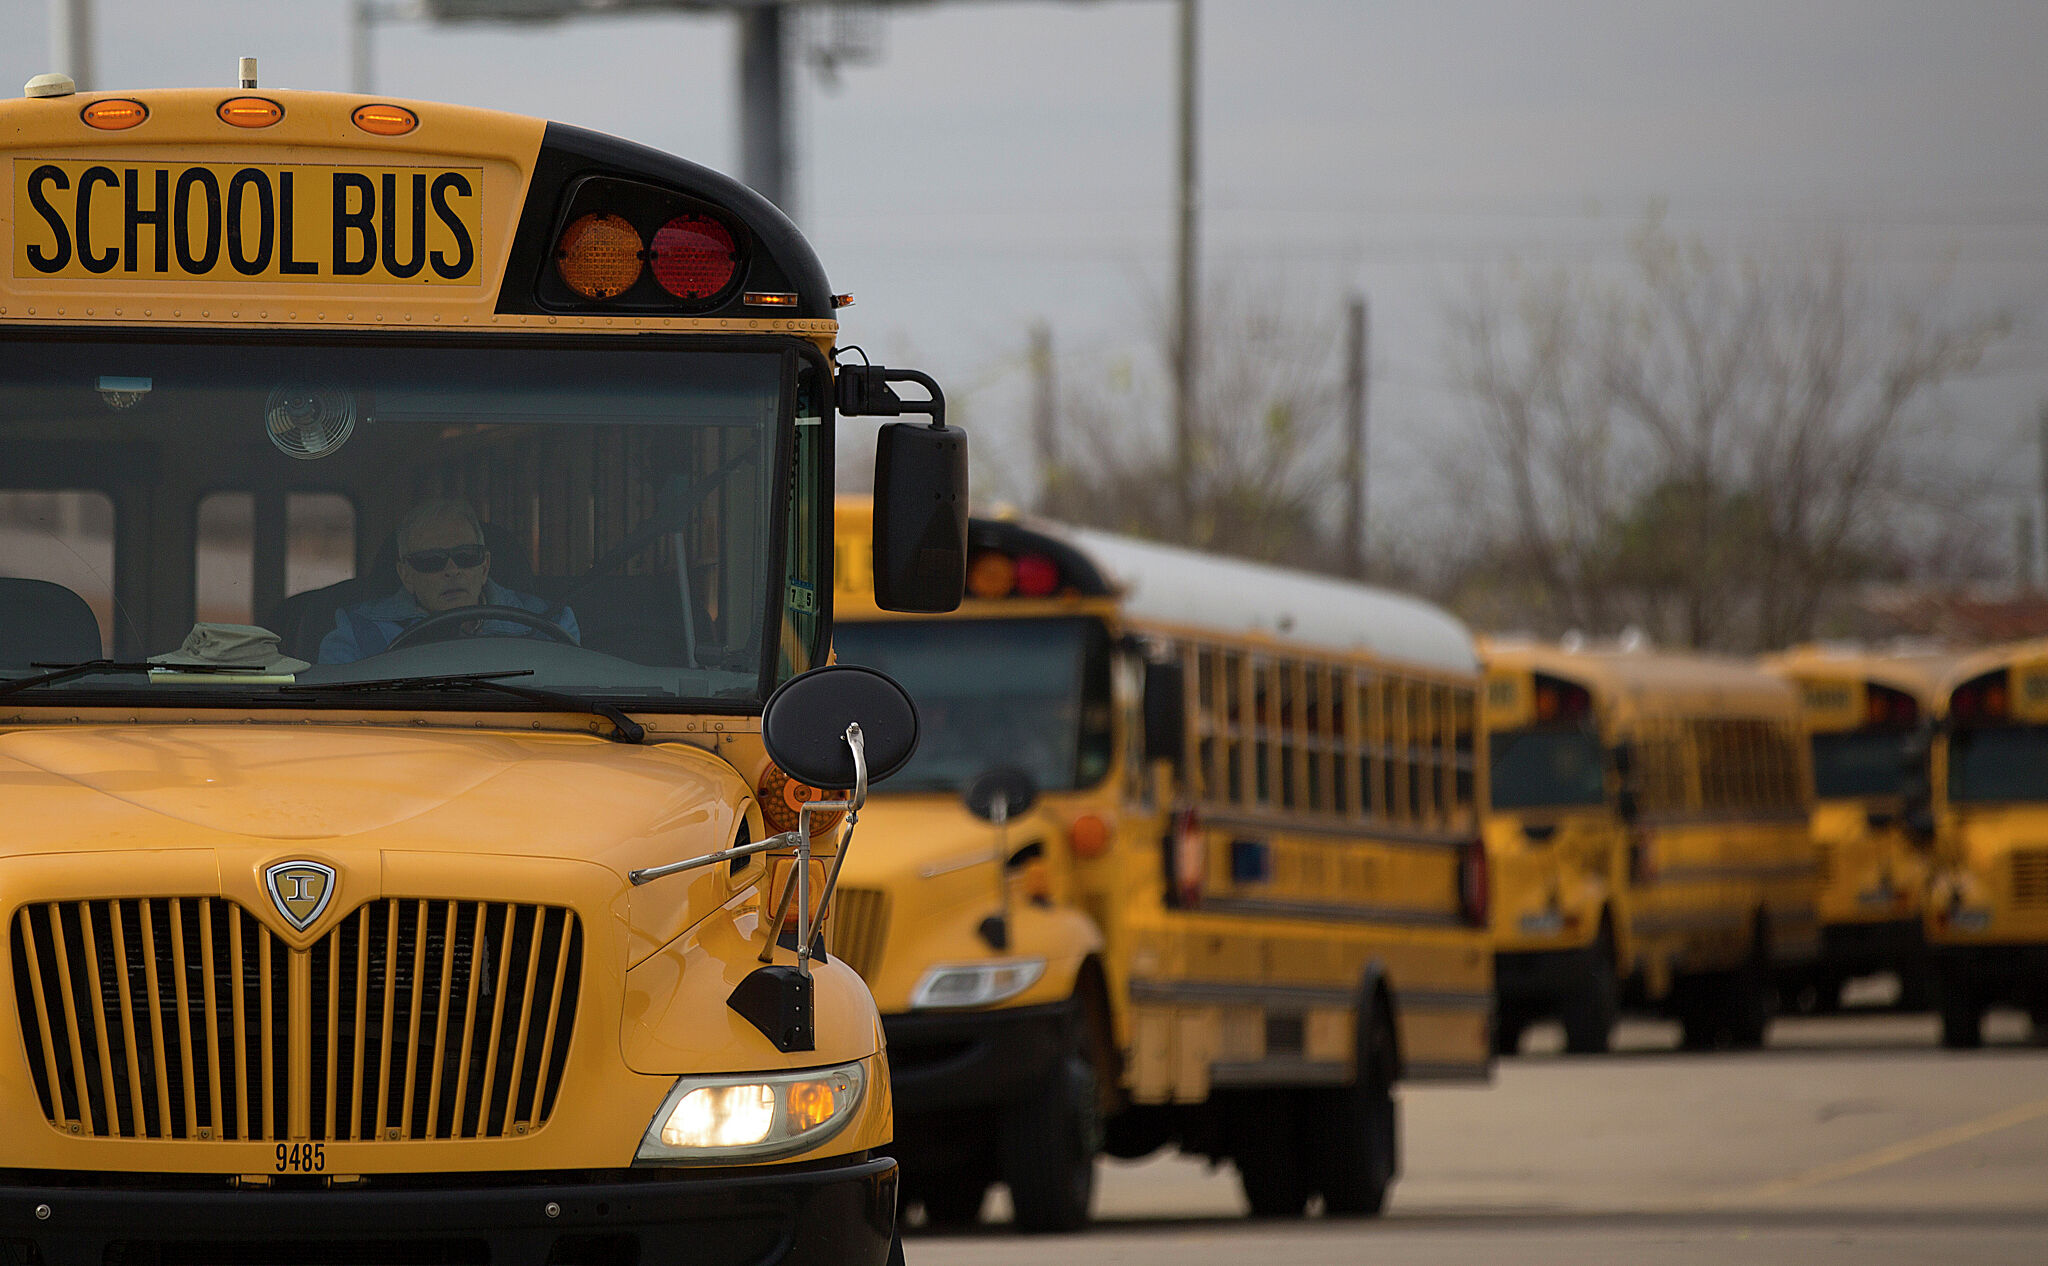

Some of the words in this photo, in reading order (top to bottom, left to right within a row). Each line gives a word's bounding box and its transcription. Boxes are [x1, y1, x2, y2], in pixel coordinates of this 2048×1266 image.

[26, 164, 319, 276] SCHOOL
[332, 171, 475, 280] BUS
[791, 588, 796, 603] 7
[806, 592, 812, 607] 5
[275, 1143, 325, 1172] 9485
